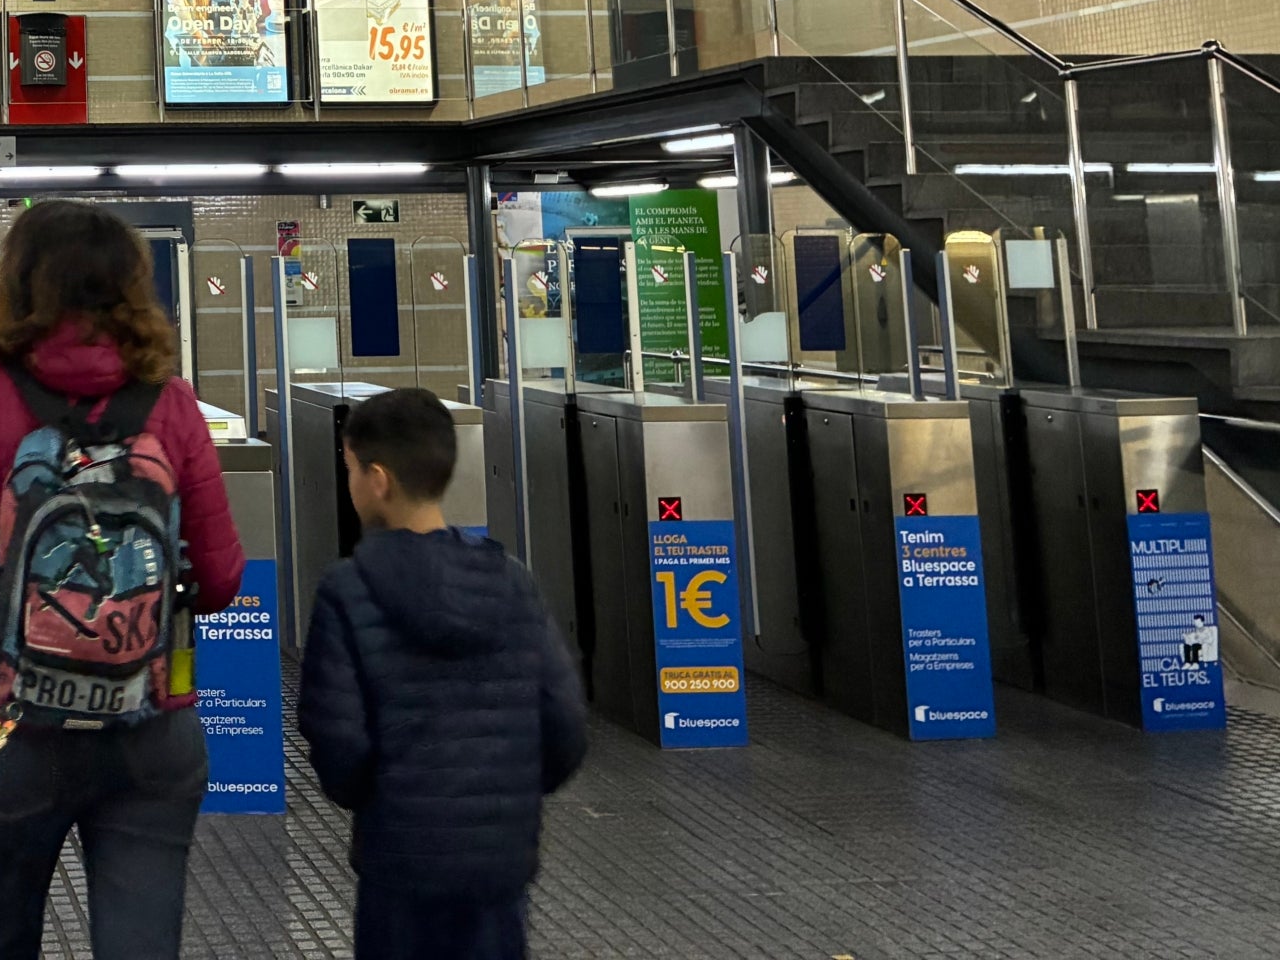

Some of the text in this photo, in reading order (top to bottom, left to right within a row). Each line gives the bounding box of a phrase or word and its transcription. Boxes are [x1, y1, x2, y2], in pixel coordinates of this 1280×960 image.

[167, 16, 252, 33] Open Day
[370, 26, 425, 62] 15,95
[647, 205, 697, 215] COMPROMÍS
[655, 217, 666, 225] EL
[667, 217, 704, 225] PLANETA
[696, 226, 708, 234] DE
[900, 530, 944, 544] Tenim
[902, 545, 967, 558] 3 centres
[902, 559, 976, 575] Bluespace
[903, 574, 978, 587] a Terrassa
[656, 569, 731, 628] 1€
[199, 625, 272, 640] Terrassa
[1142, 671, 1211, 688] EL TEU PIS.
[929, 710, 988, 721] bluespace
[679, 718, 740, 729] bluespace
[208, 782, 278, 795] bluespace
